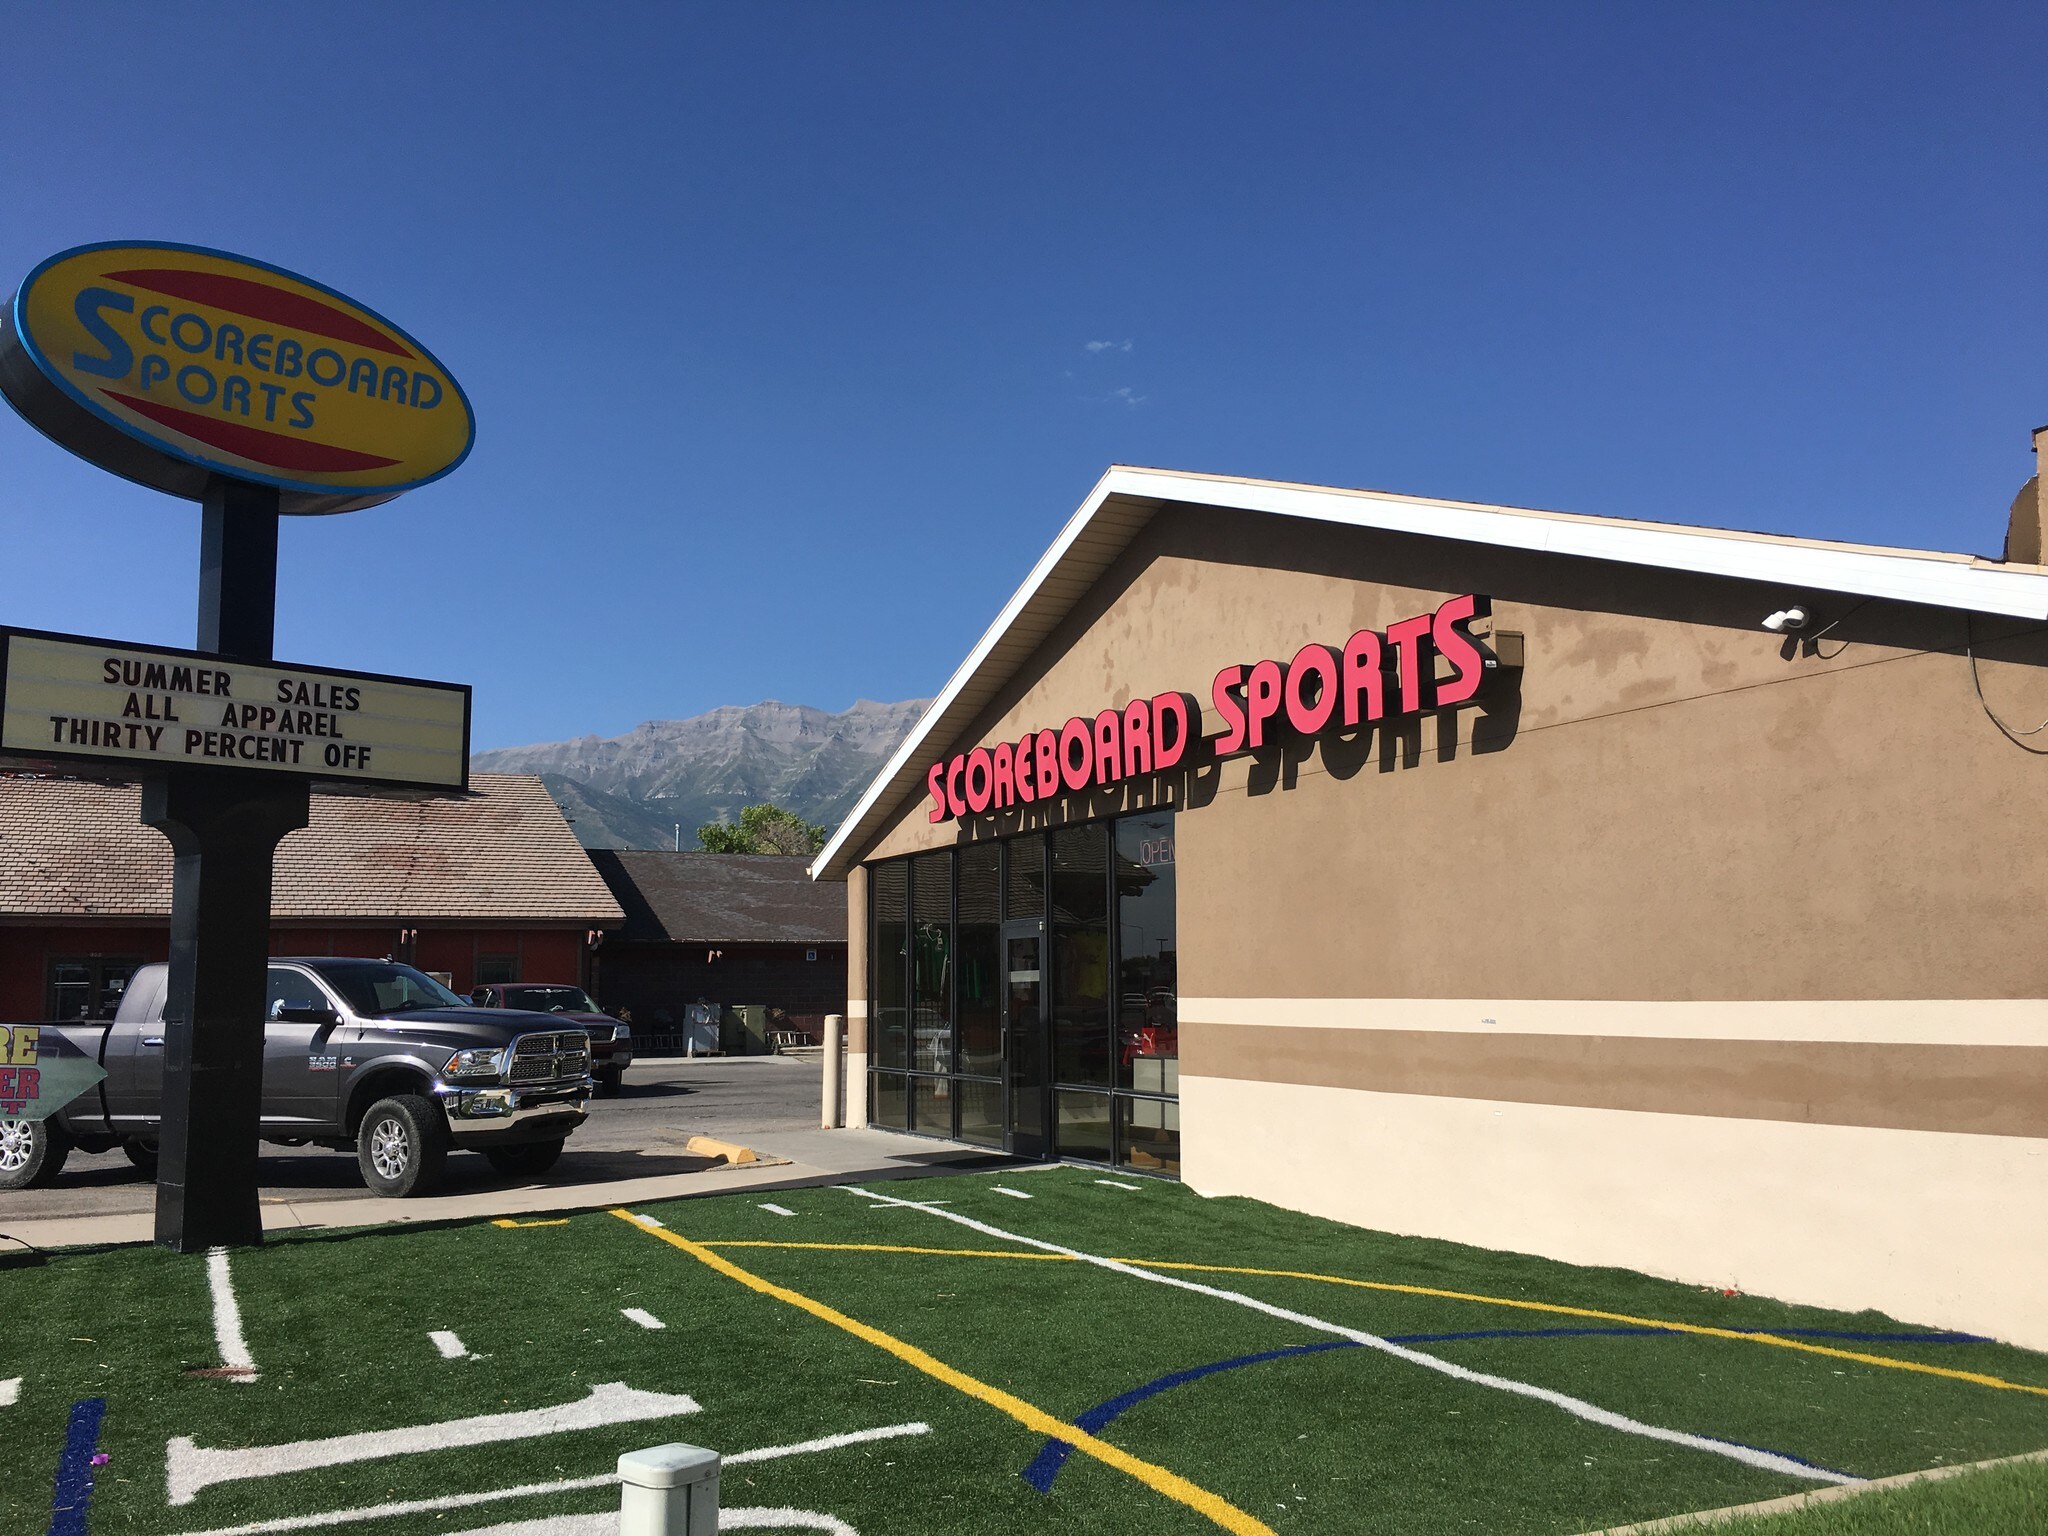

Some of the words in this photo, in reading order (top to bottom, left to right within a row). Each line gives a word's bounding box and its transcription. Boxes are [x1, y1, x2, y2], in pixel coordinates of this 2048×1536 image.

[73, 287, 443, 410] SCOREBOARD
[102, 657, 231, 697] SUMMER
[277, 679, 361, 712] SALES
[927, 690, 1190, 824] SCOREBOARD
[1212, 594, 1483, 756] SPORTS
[50, 716, 165, 752] THIRTY
[185, 729, 304, 765] PERCENT
[323, 743, 372, 770] OFF
[122, 692, 180, 723] ALL
[220, 702, 344, 739] APPAREL
